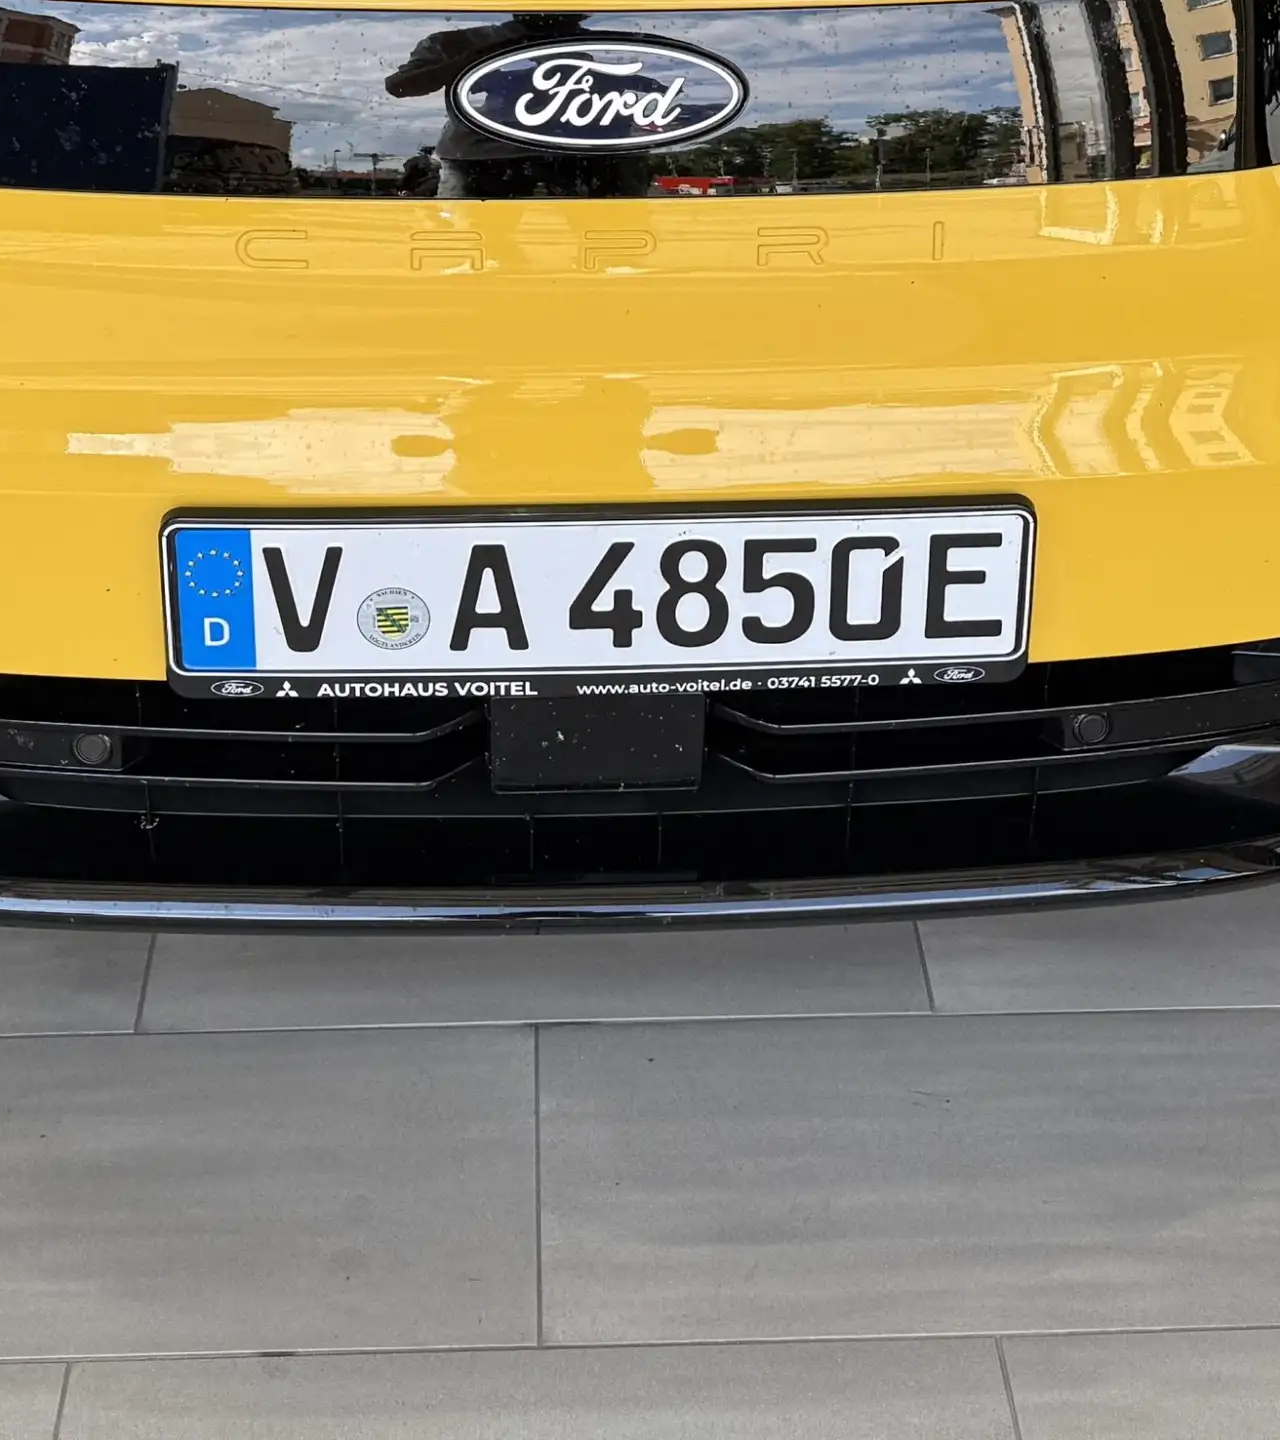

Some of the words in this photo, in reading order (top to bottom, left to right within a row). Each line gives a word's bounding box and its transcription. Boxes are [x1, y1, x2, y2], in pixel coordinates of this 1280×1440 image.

[514, 58, 687, 127] Ford
[234, 220, 946, 271] CAPRI
[262, 546, 343, 653] V
[449, 543, 530, 652] A
[569, 532, 1003, 648] 4850E
[203, 617, 230, 647] D
[316, 681, 449, 698] AUTOHAUS
[454, 680, 538, 696] VOITEL
[576, 676, 753, 695] www.auto-voitel.de
[767, 675, 816, 690] 03741
[820, 673, 880, 688] 5577-0
